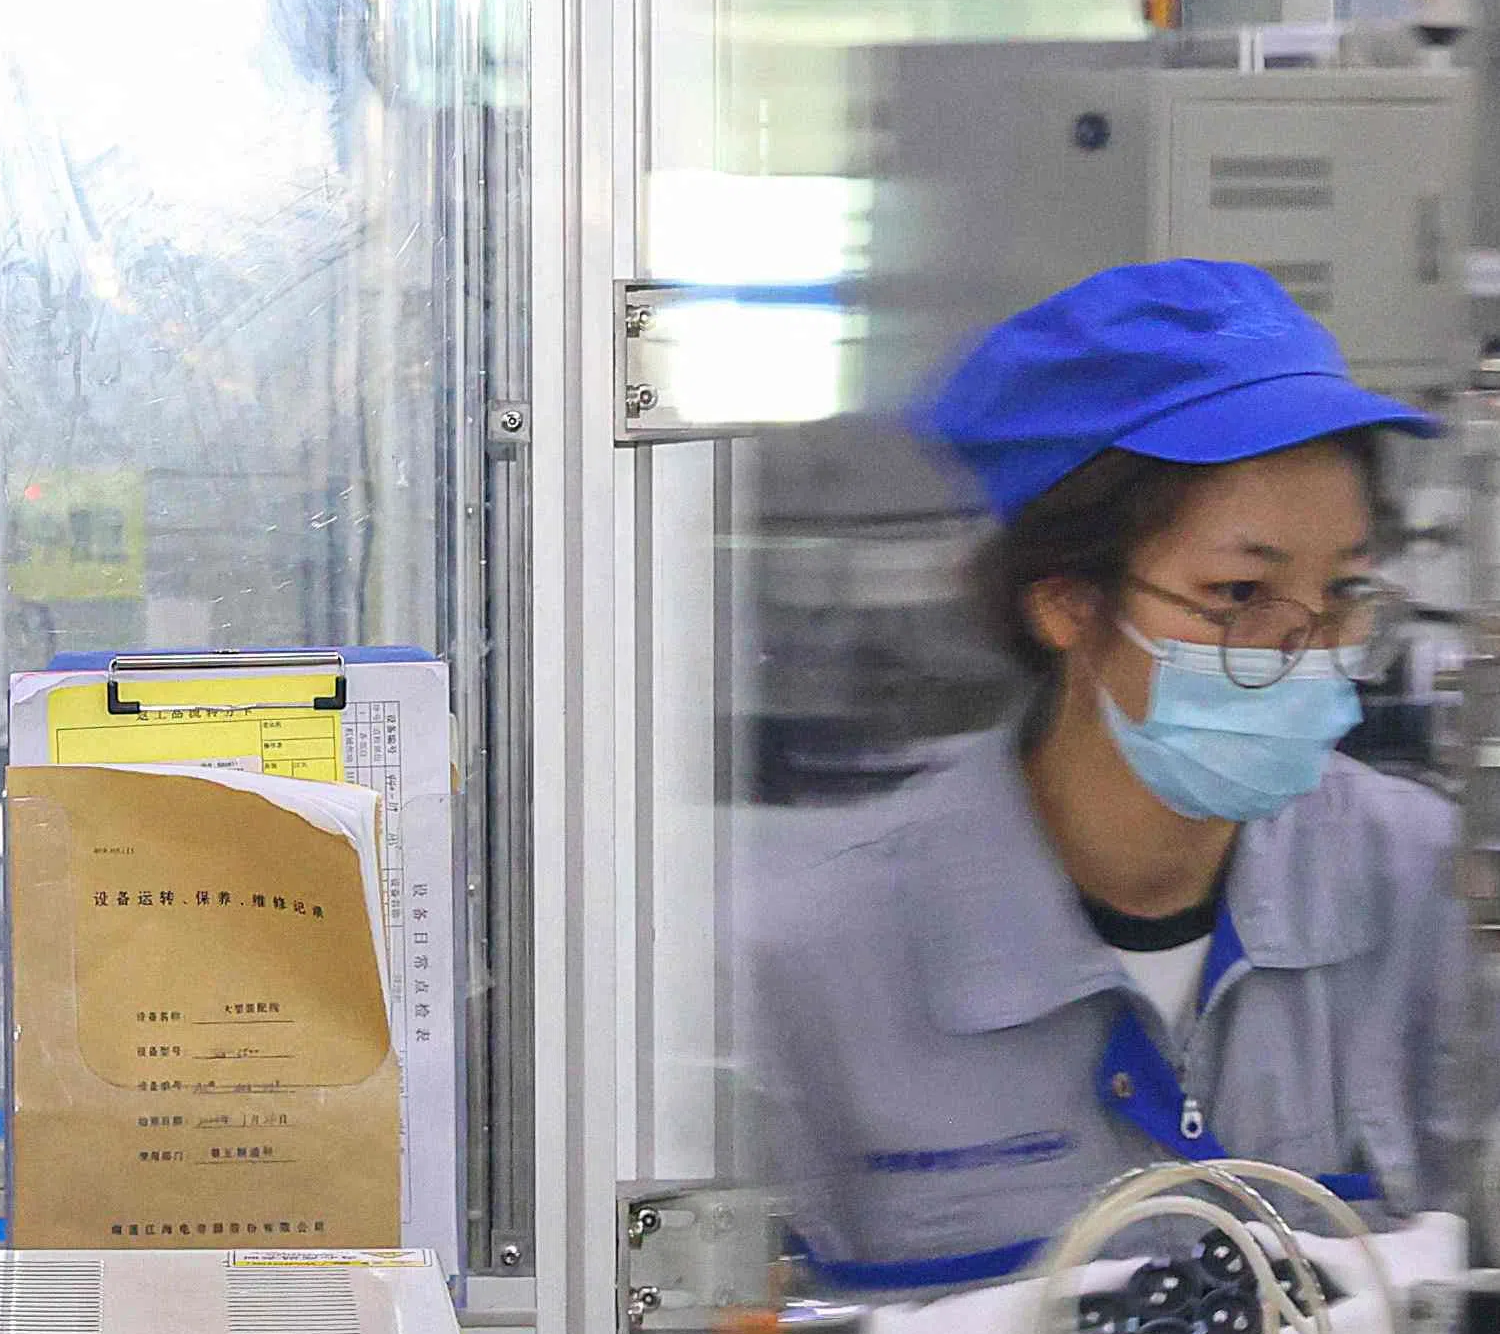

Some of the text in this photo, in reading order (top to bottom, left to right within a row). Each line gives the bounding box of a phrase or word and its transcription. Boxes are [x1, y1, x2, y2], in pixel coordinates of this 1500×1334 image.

[412, 883, 431, 1042] 设备日常点检表
